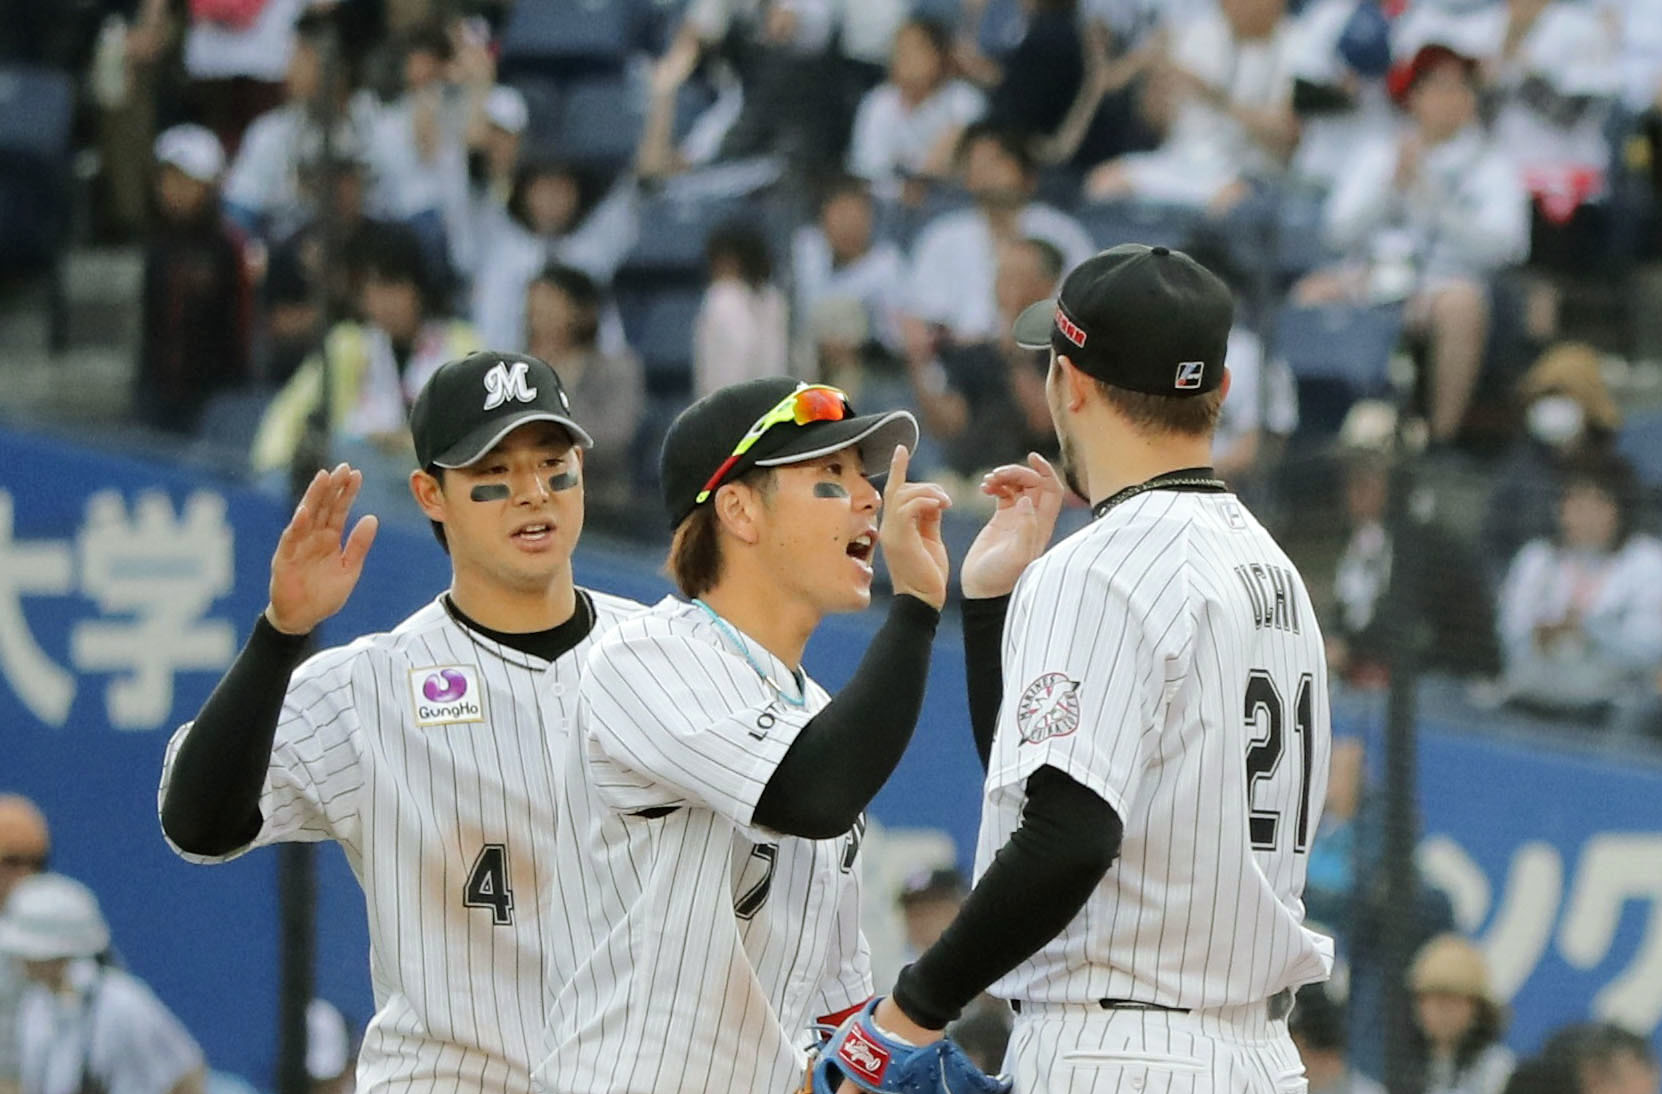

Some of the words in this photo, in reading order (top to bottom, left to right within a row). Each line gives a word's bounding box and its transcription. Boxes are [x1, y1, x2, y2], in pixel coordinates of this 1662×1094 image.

[483, 361, 537, 411] M
[1234, 563, 1300, 635] UCHI
[419, 702, 479, 719] GungHo
[1244, 669, 1313, 853] 21
[463, 843, 515, 926] 4
